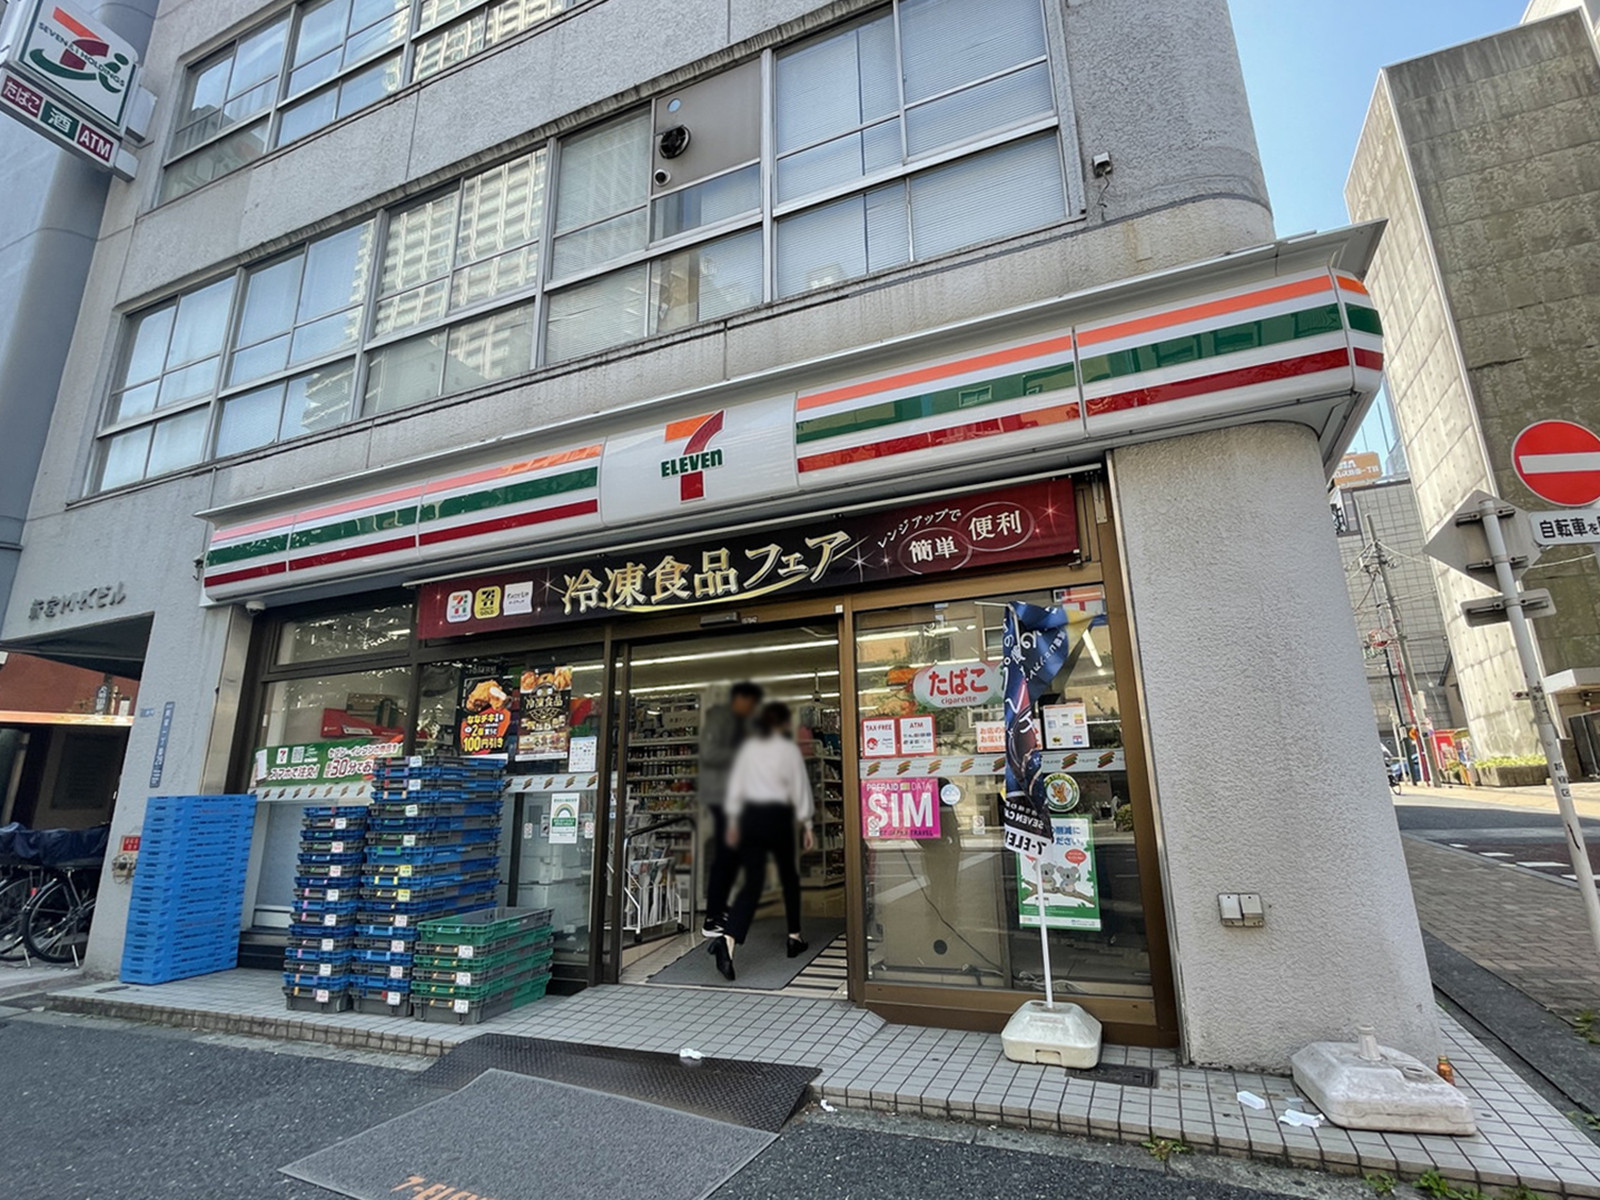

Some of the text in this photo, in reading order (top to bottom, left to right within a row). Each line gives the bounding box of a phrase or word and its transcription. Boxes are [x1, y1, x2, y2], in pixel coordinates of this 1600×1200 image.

[38, 21, 69, 49] SEVEN
[80, 51, 126, 87] HOLDINGS
[4, 81, 40, 114] たばこ
[48, 107, 74, 134] 酒
[80, 130, 111, 158] ATM
[877, 508, 961, 548] レンジアップで
[967, 510, 1022, 541] 便利
[1540, 516, 1600, 539] 自転車を
[907, 536, 959, 564] 簡単
[562, 530, 851, 615] 冷凍食品フェア
[928, 667, 989, 697] たばこ
[940, 694, 978, 706] cigarette
[909, 721, 924, 729] ATM
[866, 781, 932, 792] PREPAID DATA
[867, 792, 934, 828] SIM
